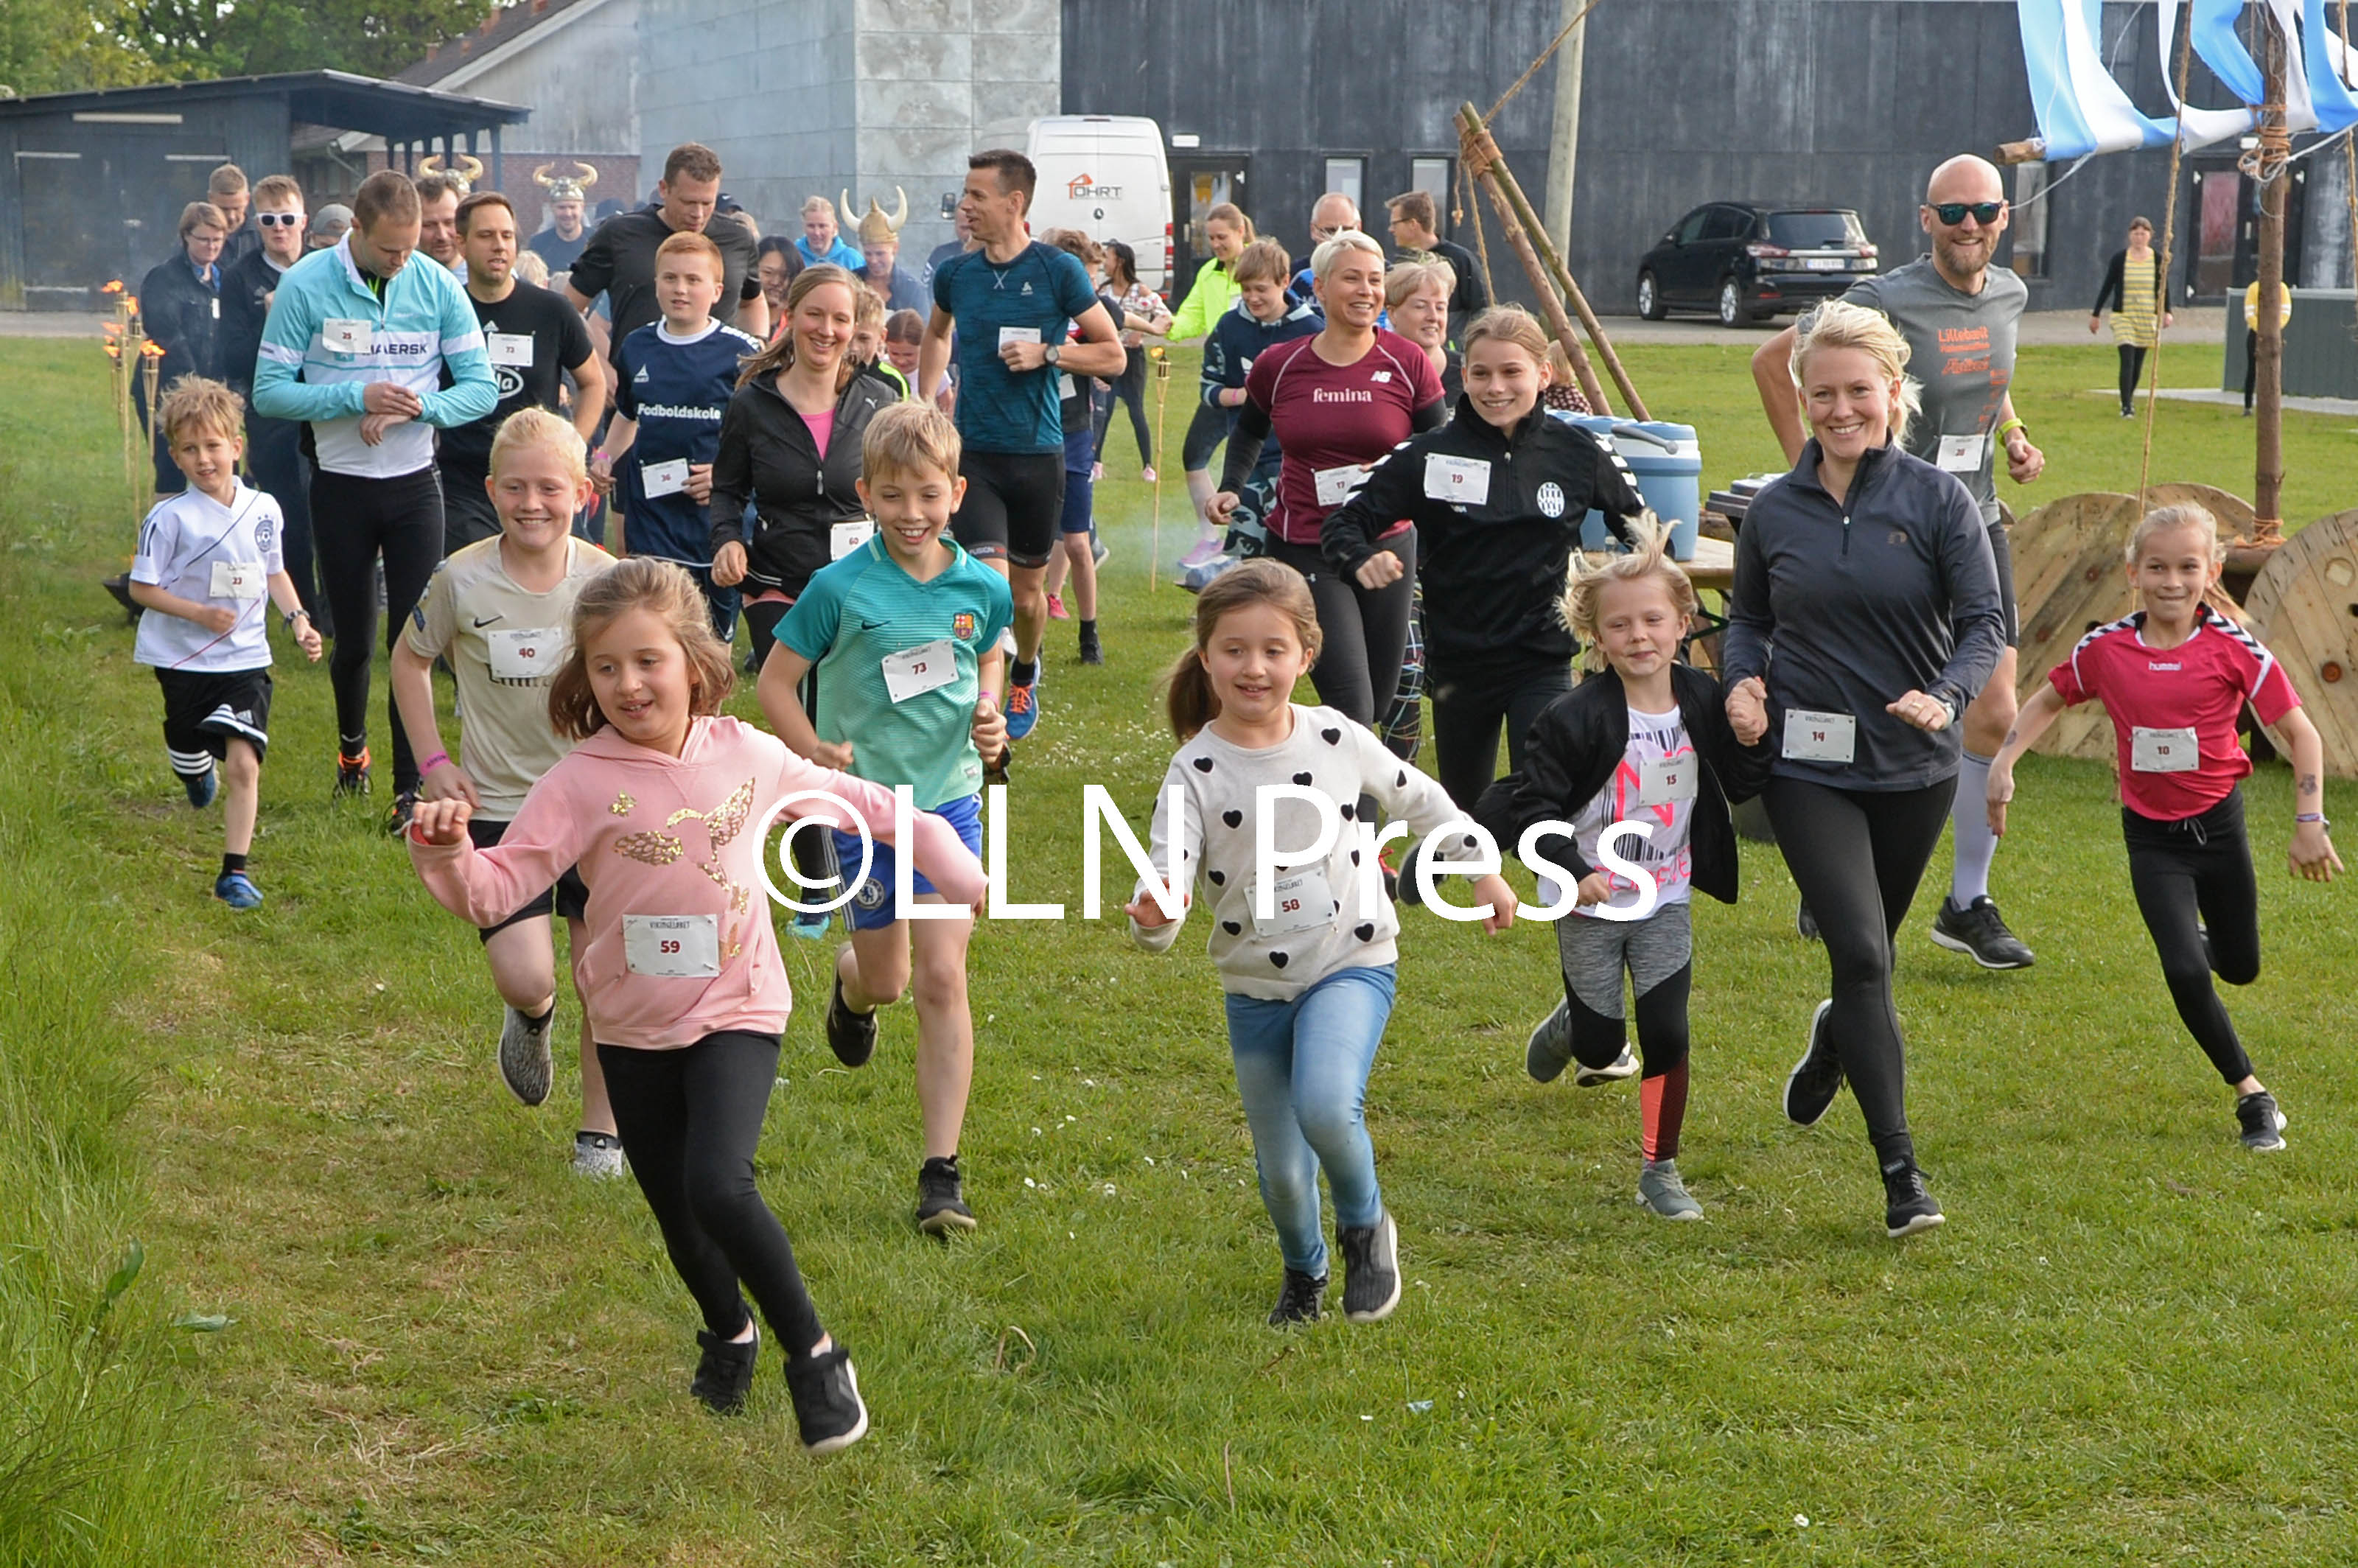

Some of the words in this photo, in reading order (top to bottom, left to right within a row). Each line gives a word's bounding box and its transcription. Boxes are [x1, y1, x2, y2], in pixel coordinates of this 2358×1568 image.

[1313, 388, 1372, 402] femina
[637, 403, 721, 419] Fodboldskole
[1451, 474, 1463, 483] 19
[519, 648, 535, 658] 40
[912, 662, 927, 674] 73
[2157, 746, 2170, 755] 10
[1665, 774, 1676, 785] 15
[1281, 898, 1301, 913] 58
[660, 940, 681, 953] 59
